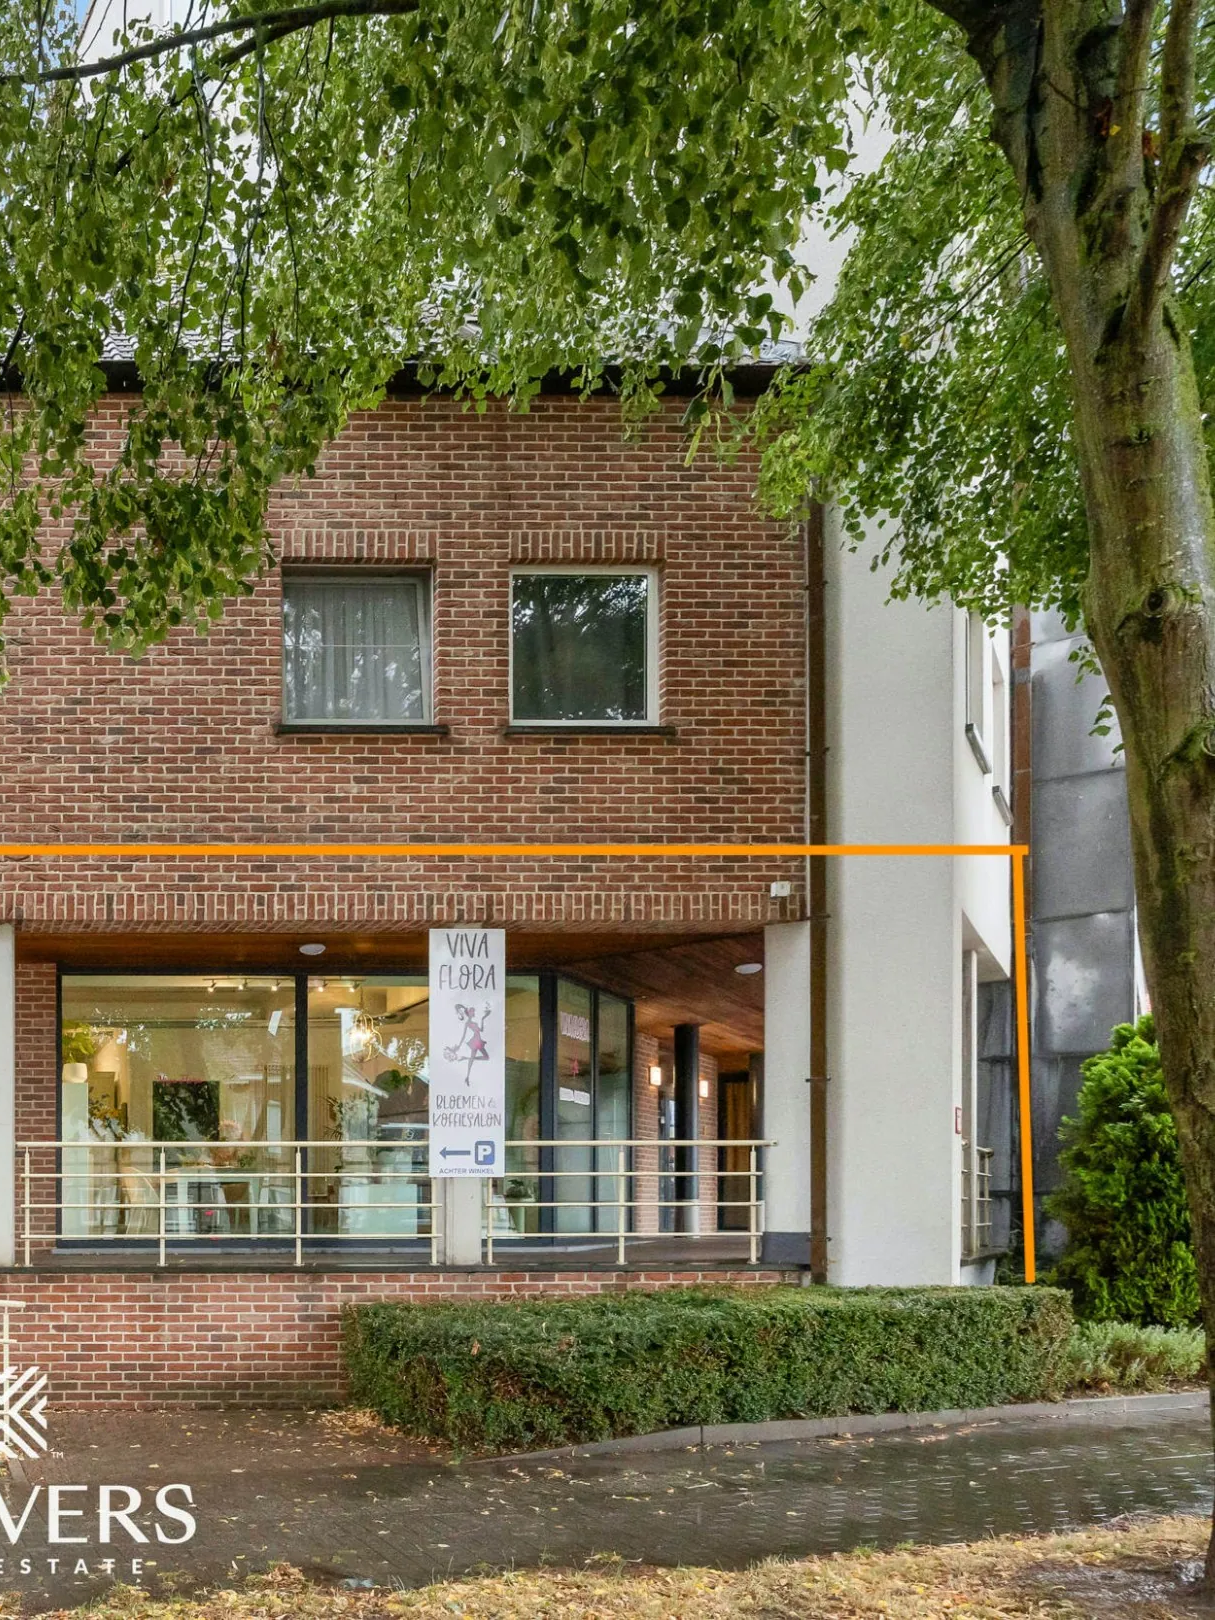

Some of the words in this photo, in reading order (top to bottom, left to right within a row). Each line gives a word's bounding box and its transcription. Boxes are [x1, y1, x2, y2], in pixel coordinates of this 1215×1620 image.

[446, 932, 489, 959] VIVA
[439, 964, 496, 991] FLORA
[436, 1094, 486, 1110] BLOEMEN
[432, 1112, 502, 1128] KOFFIESALON
